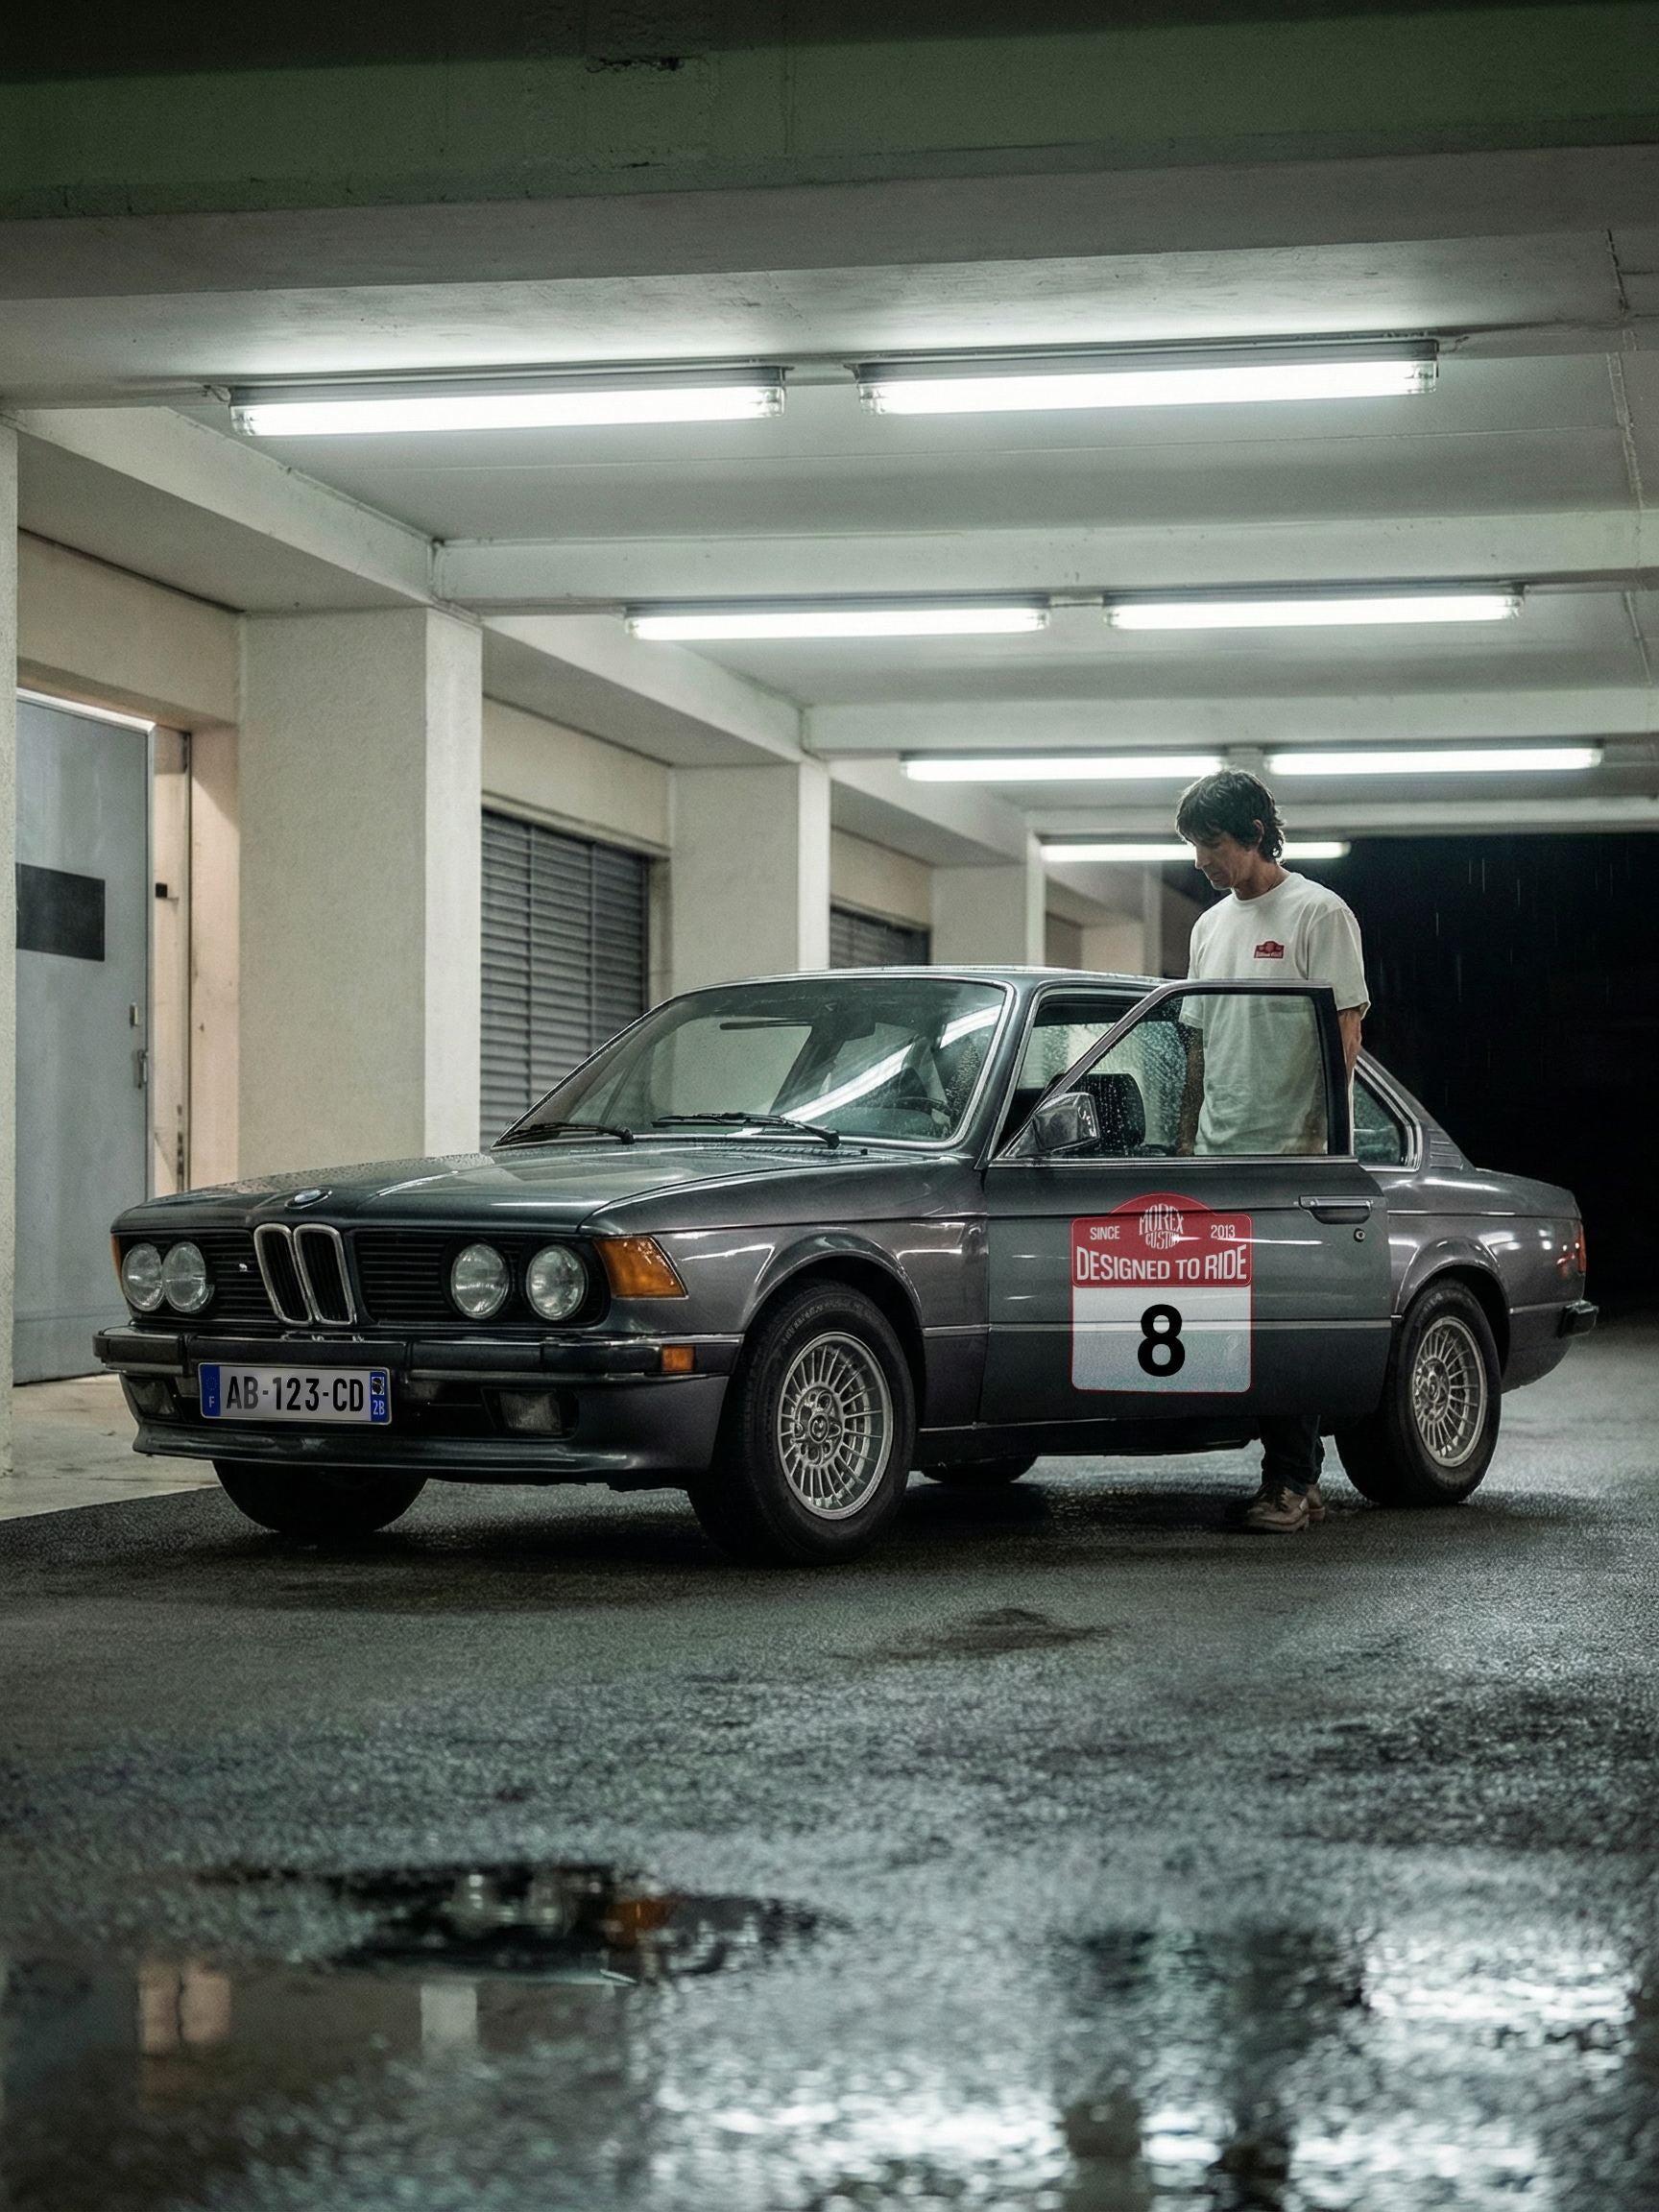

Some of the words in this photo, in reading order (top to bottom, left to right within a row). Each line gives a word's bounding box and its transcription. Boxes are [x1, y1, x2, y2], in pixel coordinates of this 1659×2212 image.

[1139, 1203, 1184, 1236] MOREX
[1211, 1224, 1236, 1238] 2013
[1090, 1226, 1120, 1240] SINCE
[1076, 1245, 1170, 1281] DESIGNED
[1175, 1259, 1200, 1280] TO
[1205, 1244, 1247, 1280] RIDE
[1137, 1304, 1186, 1378] 8
[207, 1396, 216, 1408] F
[227, 1376, 364, 1412] AB-123-CD
[373, 1399, 385, 1415] 2B
